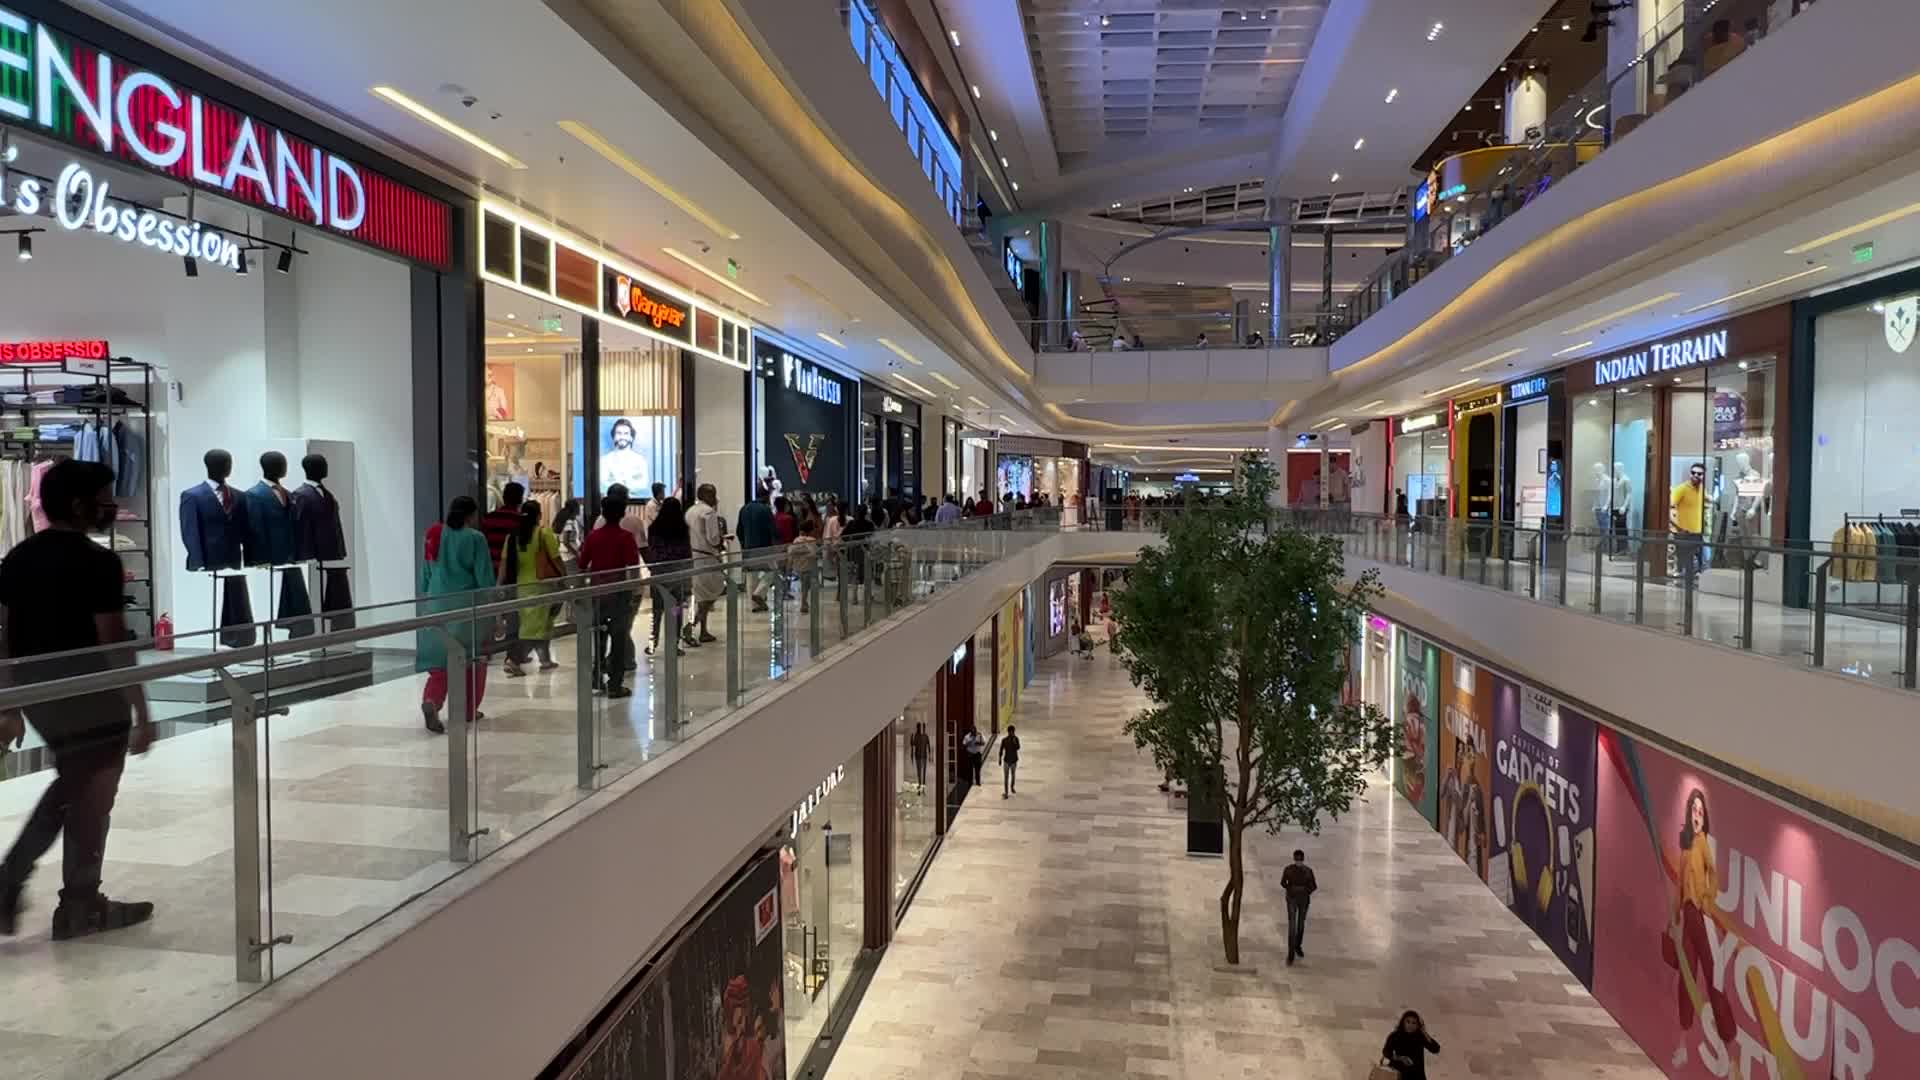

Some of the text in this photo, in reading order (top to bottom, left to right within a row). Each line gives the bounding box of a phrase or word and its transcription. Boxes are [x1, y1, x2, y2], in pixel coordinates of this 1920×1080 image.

[0, 7, 366, 232] ENGLAND
[56, 162, 241, 270] Obsession
[1595, 330, 1728, 385] INDIAN TERRAIN
[1445, 704, 1489, 759] CINEMA
[1512, 733, 1559, 770] CAPITAL OF
[1496, 739, 1580, 825] GADGETS
[1703, 914, 1875, 1080] YOUR
